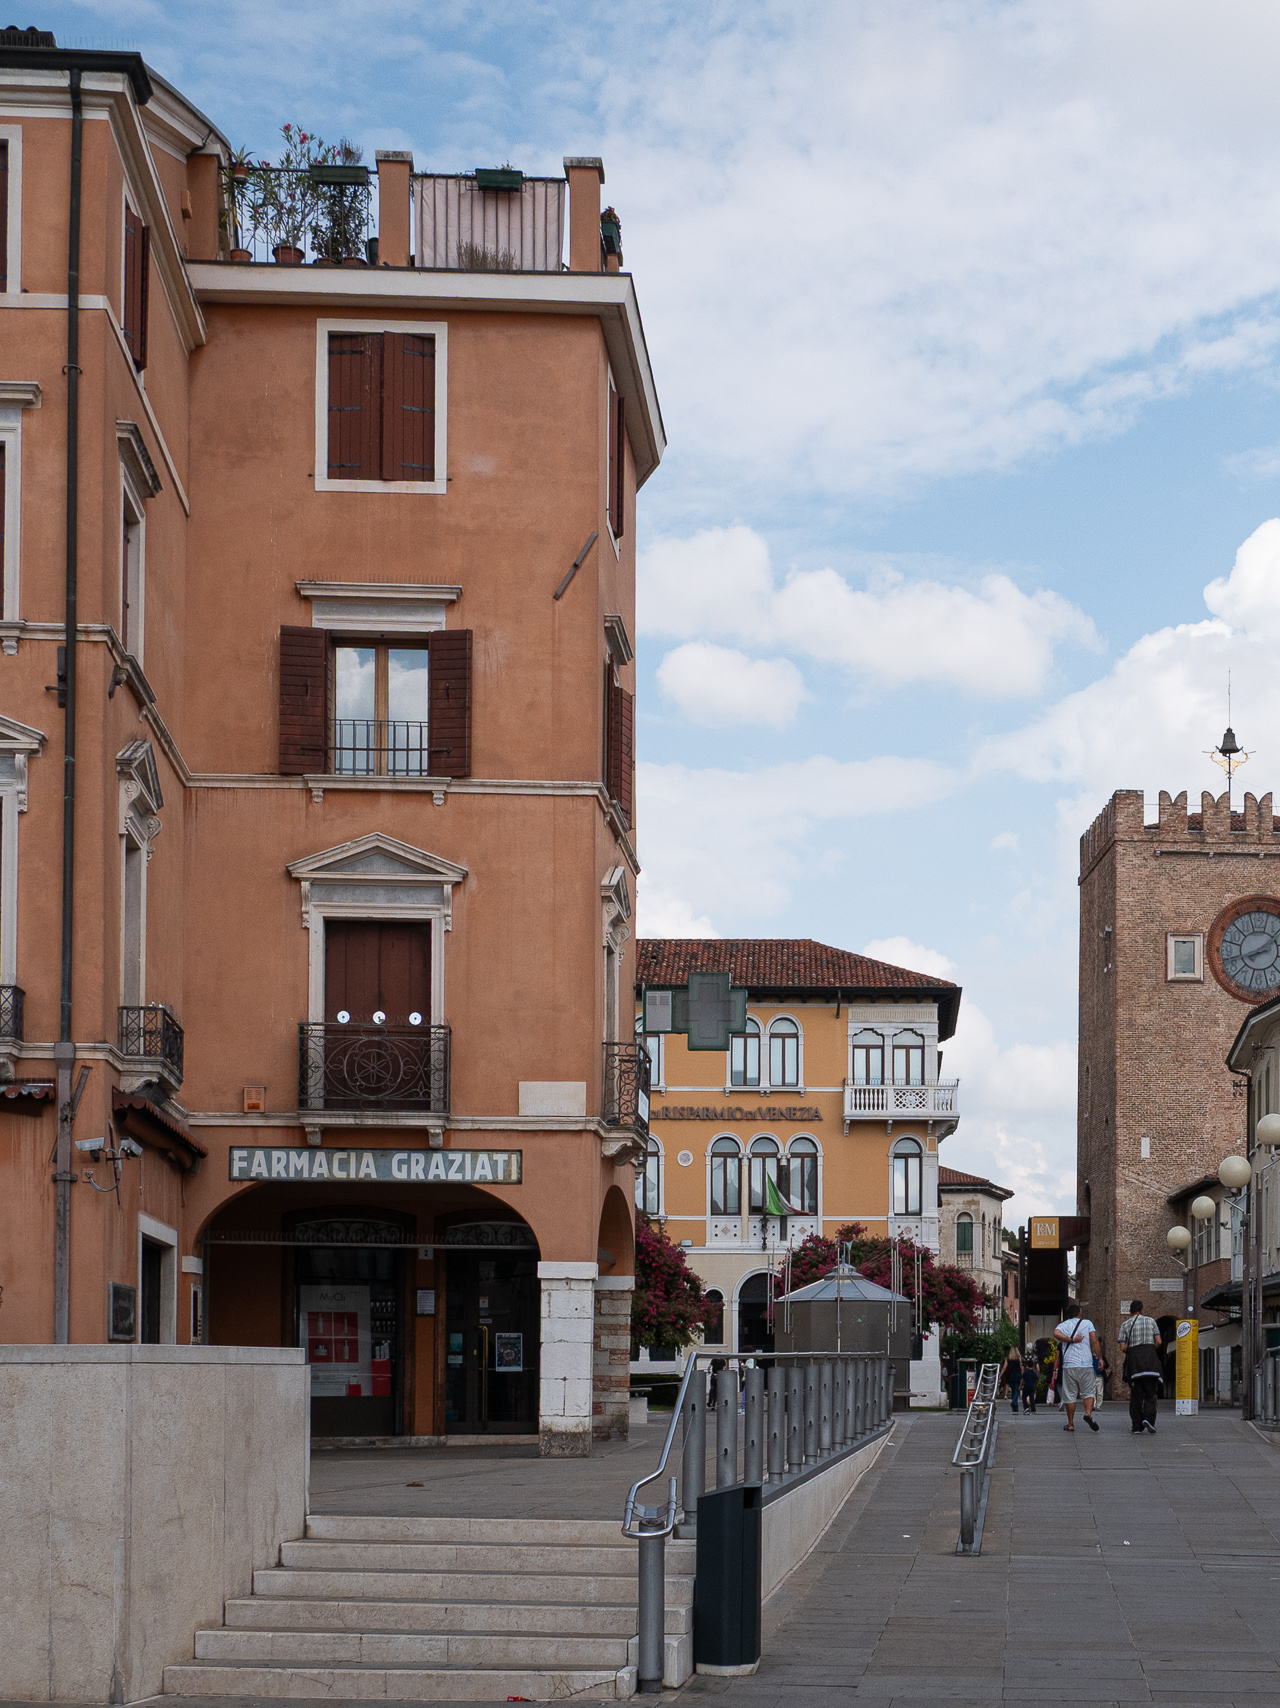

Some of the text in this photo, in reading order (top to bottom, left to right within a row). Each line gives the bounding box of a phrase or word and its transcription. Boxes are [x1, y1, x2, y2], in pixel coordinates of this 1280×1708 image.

[1242, 920, 1249, 932] 11
[1254, 917, 1264, 929] 12
[1230, 931, 1240, 942] 10
[1226, 945, 1233, 956] 9
[1230, 960, 1237, 972] 8
[1241, 971, 1276, 985] 7 6 5
[662, 1106, 745, 1121] RISPARMIO
[758, 1106, 823, 1121] VENEZIA
[232, 1150, 517, 1181] FARMACIA GRAZIATI
[424, 1249, 428, 1257] 2
